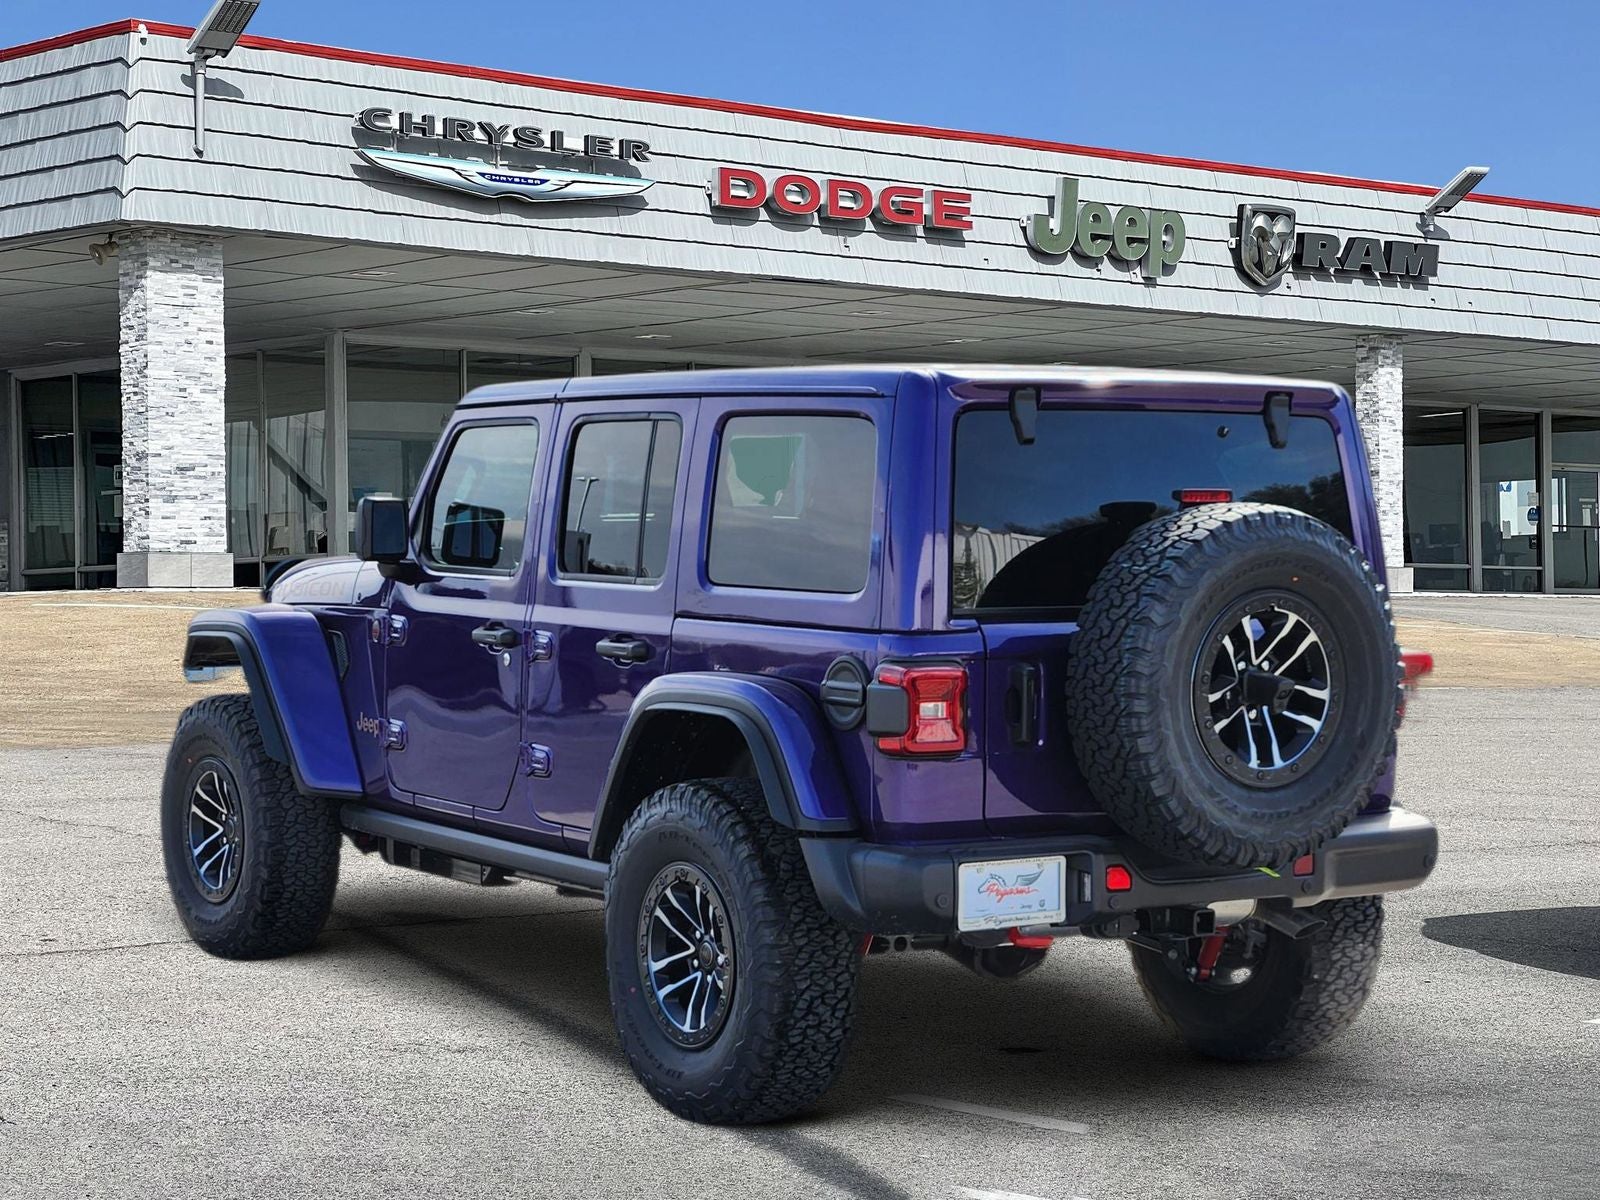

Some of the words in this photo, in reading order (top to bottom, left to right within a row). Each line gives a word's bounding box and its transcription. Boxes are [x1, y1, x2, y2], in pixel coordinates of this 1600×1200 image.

[359, 107, 650, 162] CHRYSLER
[484, 174, 541, 185] CHRYSLER
[711, 167, 973, 231] DODGE
[1026, 177, 1186, 278] Jeep
[1296, 232, 1440, 277] RAM
[356, 711, 380, 738] Jeep
